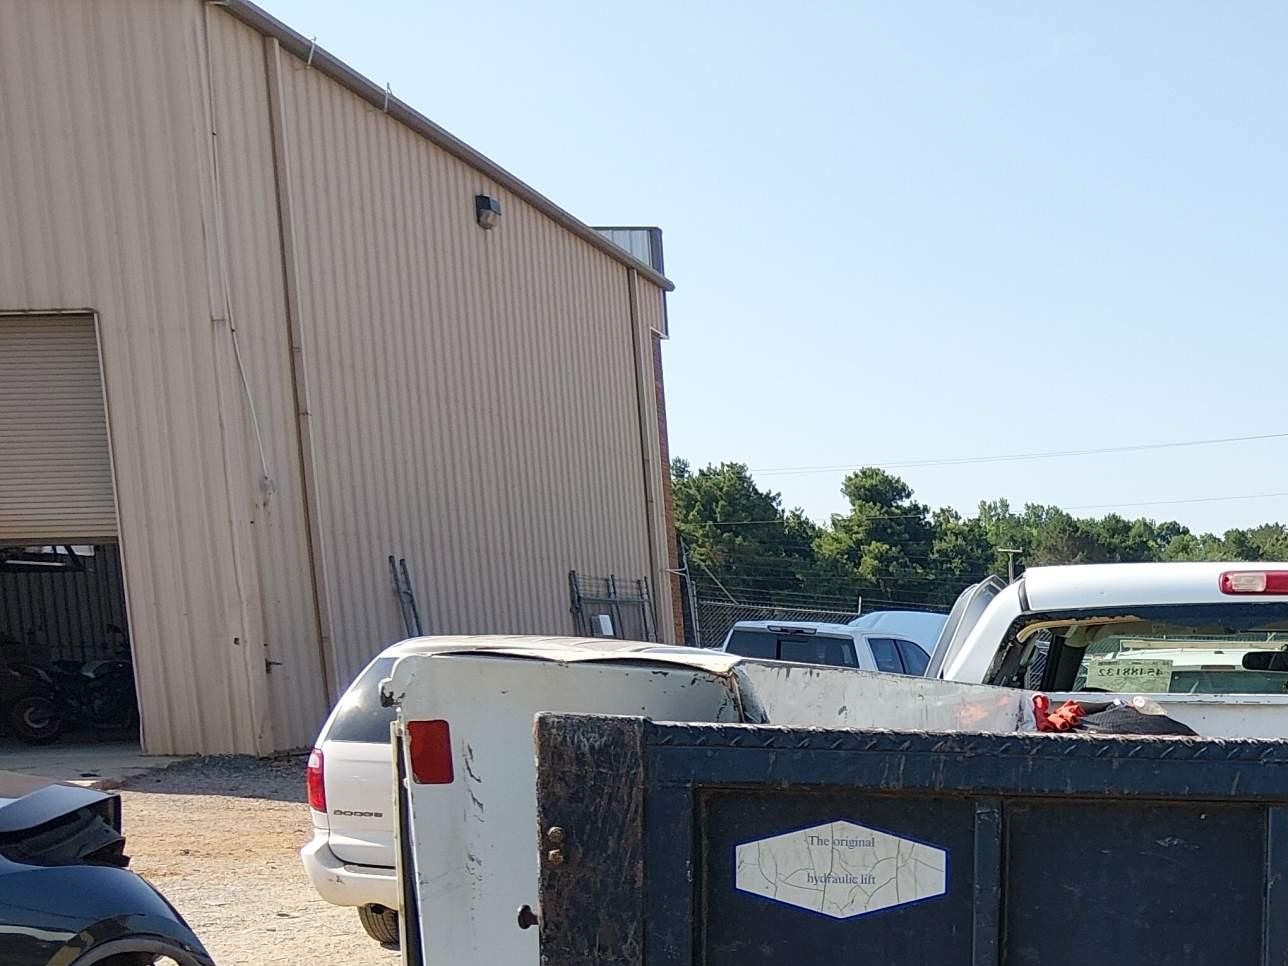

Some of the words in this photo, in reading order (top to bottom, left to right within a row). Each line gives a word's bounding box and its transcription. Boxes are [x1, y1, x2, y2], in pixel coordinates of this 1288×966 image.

[333, 809, 383, 818] DODGE
[808, 836, 830, 847] The
[833, 836, 875, 849] original
[807, 873, 858, 886] hydraulic
[860, 874, 876, 885] lift
